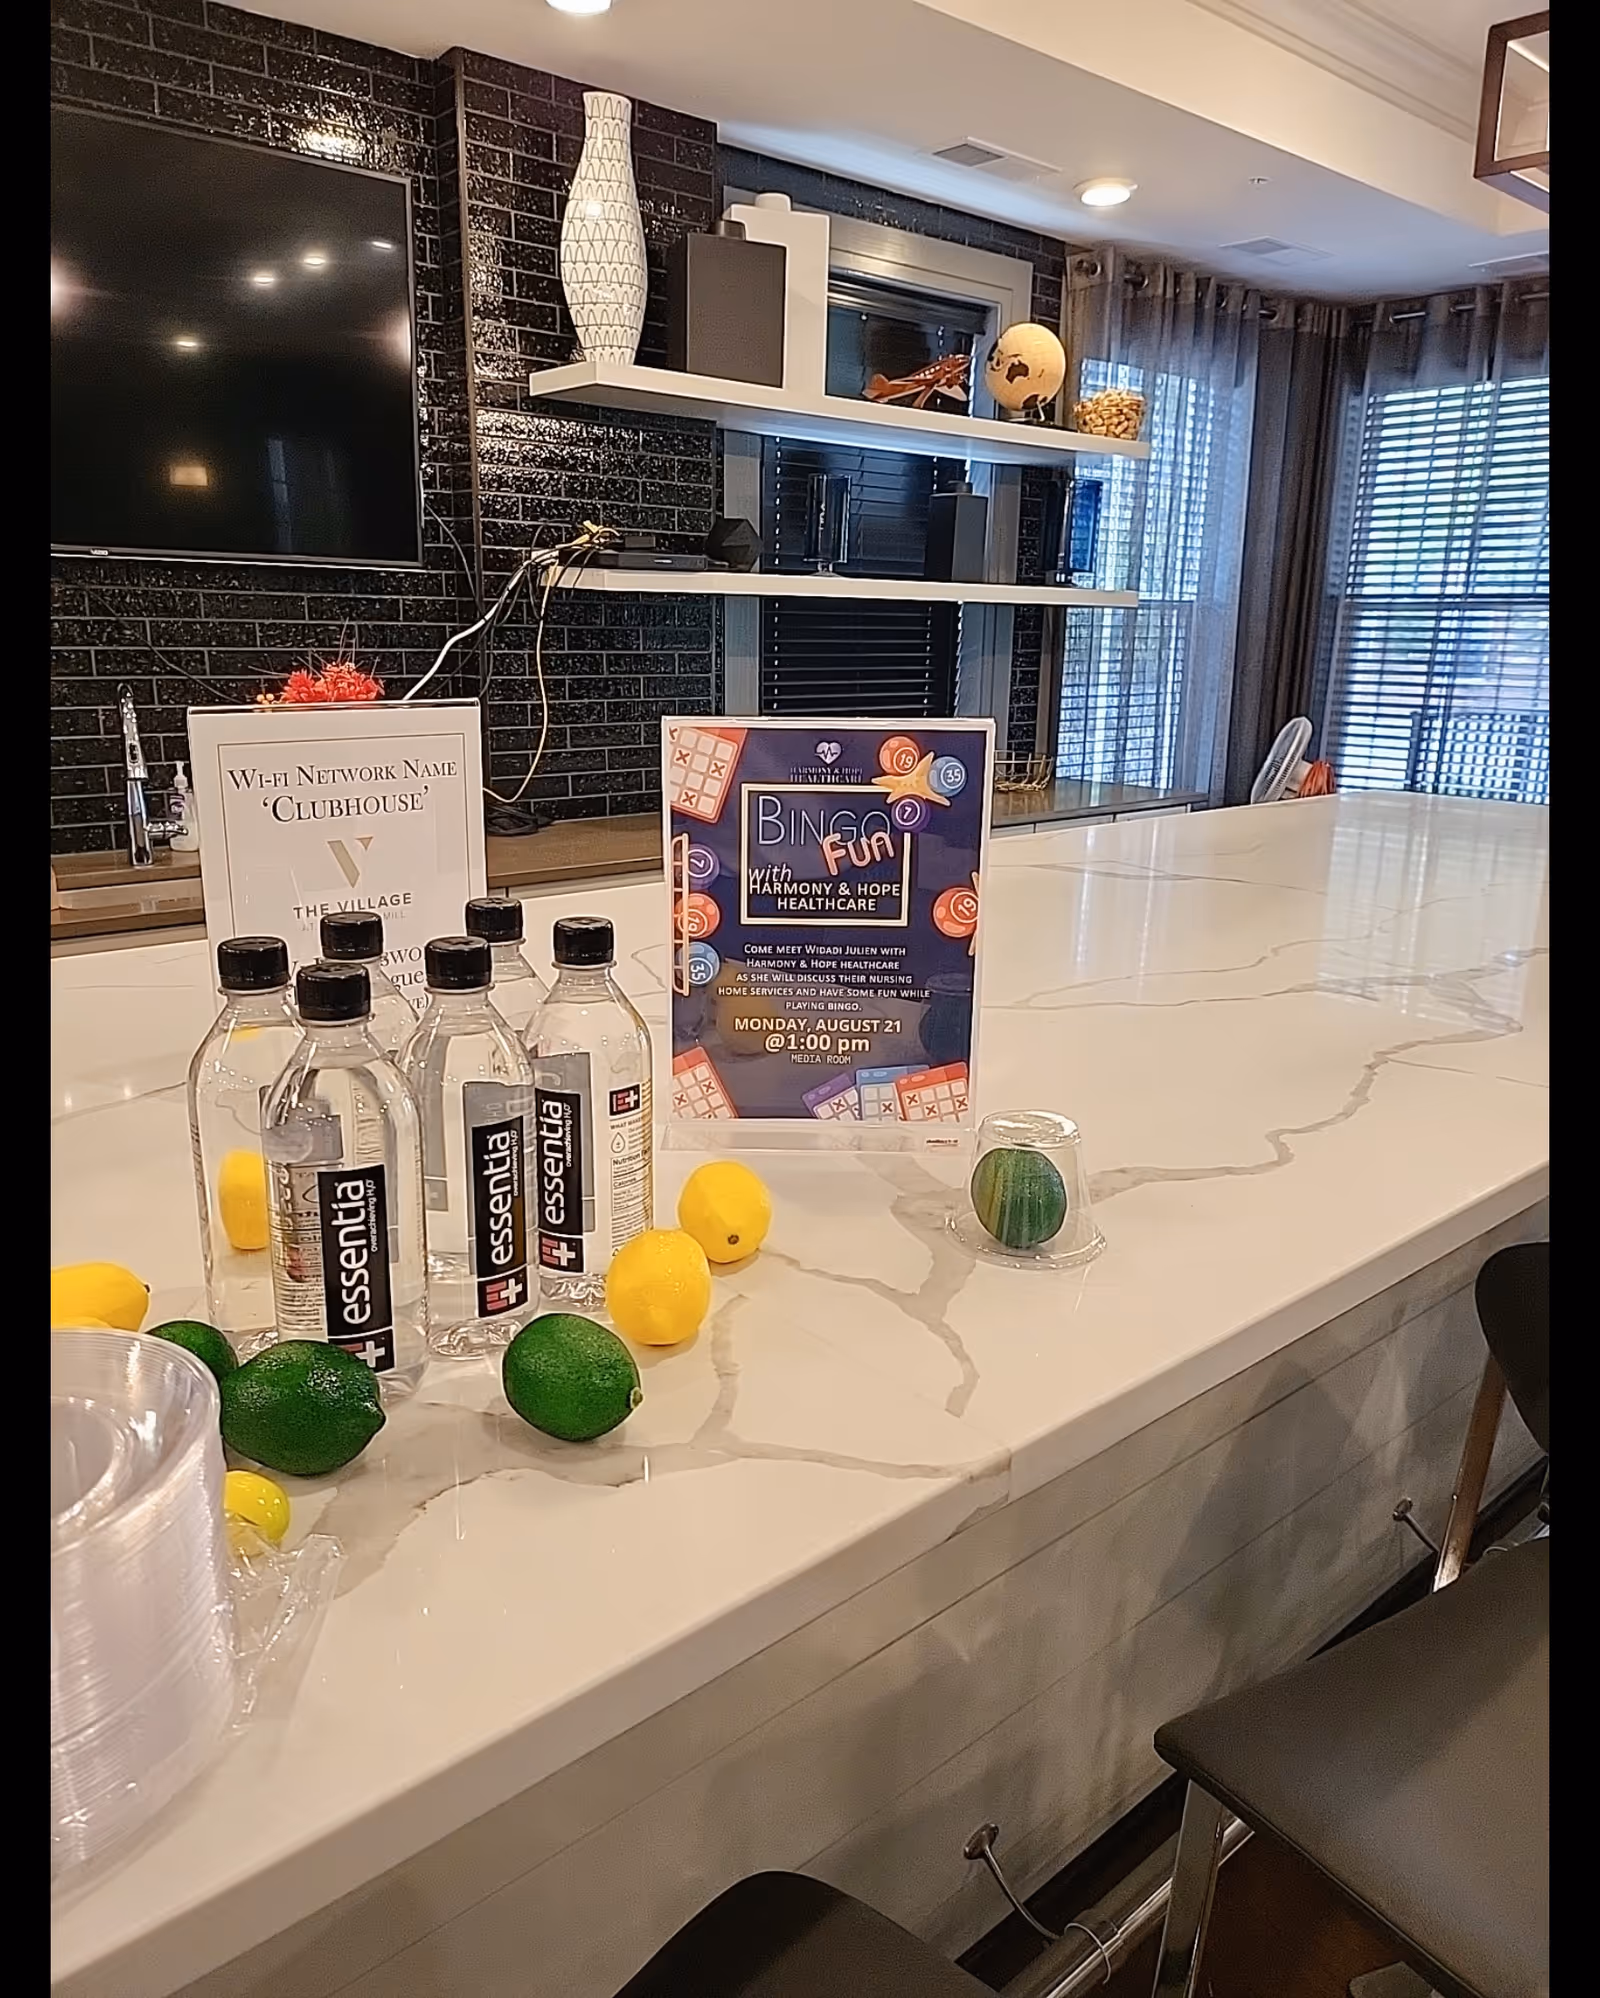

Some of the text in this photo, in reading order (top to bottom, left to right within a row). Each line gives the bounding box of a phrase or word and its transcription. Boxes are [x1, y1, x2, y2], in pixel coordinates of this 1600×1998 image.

[900, 754, 914, 767] 19
[296, 764, 397, 786] NETWORK
[402, 759, 458, 779] NAME
[946, 769, 962, 782] 35
[757, 795, 892, 846] BINGO
[749, 863, 792, 883] with
[749, 882, 900, 897] HARMONY & HOPE
[293, 892, 412, 919] THE VILLAGE
[777, 897, 877, 912] HEALTHCARE
[744, 944, 773, 954] COME
[776, 945, 802, 954] MEET
[844, 945, 877, 955] JULIEN
[880, 947, 906, 956] WITH
[746, 958, 900, 970] HARMONY & HOPE HEALTHCARE
[736, 973, 912, 984] AS SHE WILL DISCUSS THEIR NURSING
[718, 986, 930, 998] HOME SERVICES AND HAVE SOME FUN WHILE
[785, 1001, 862, 1011] PLAYING BINGO.
[735, 1018, 901, 1033] MONDAY, AUGUST 21
[765, 1033, 870, 1055] @1:00 pm
[791, 1055, 851, 1064] MEDIA ROOM
[564, 1119, 573, 1167] overachieving
[539, 1099, 565, 1225] essentia
[483, 1131, 514, 1266] essentia
[367, 1197, 378, 1253] overachieving
[331, 1179, 371, 1325] essentia
